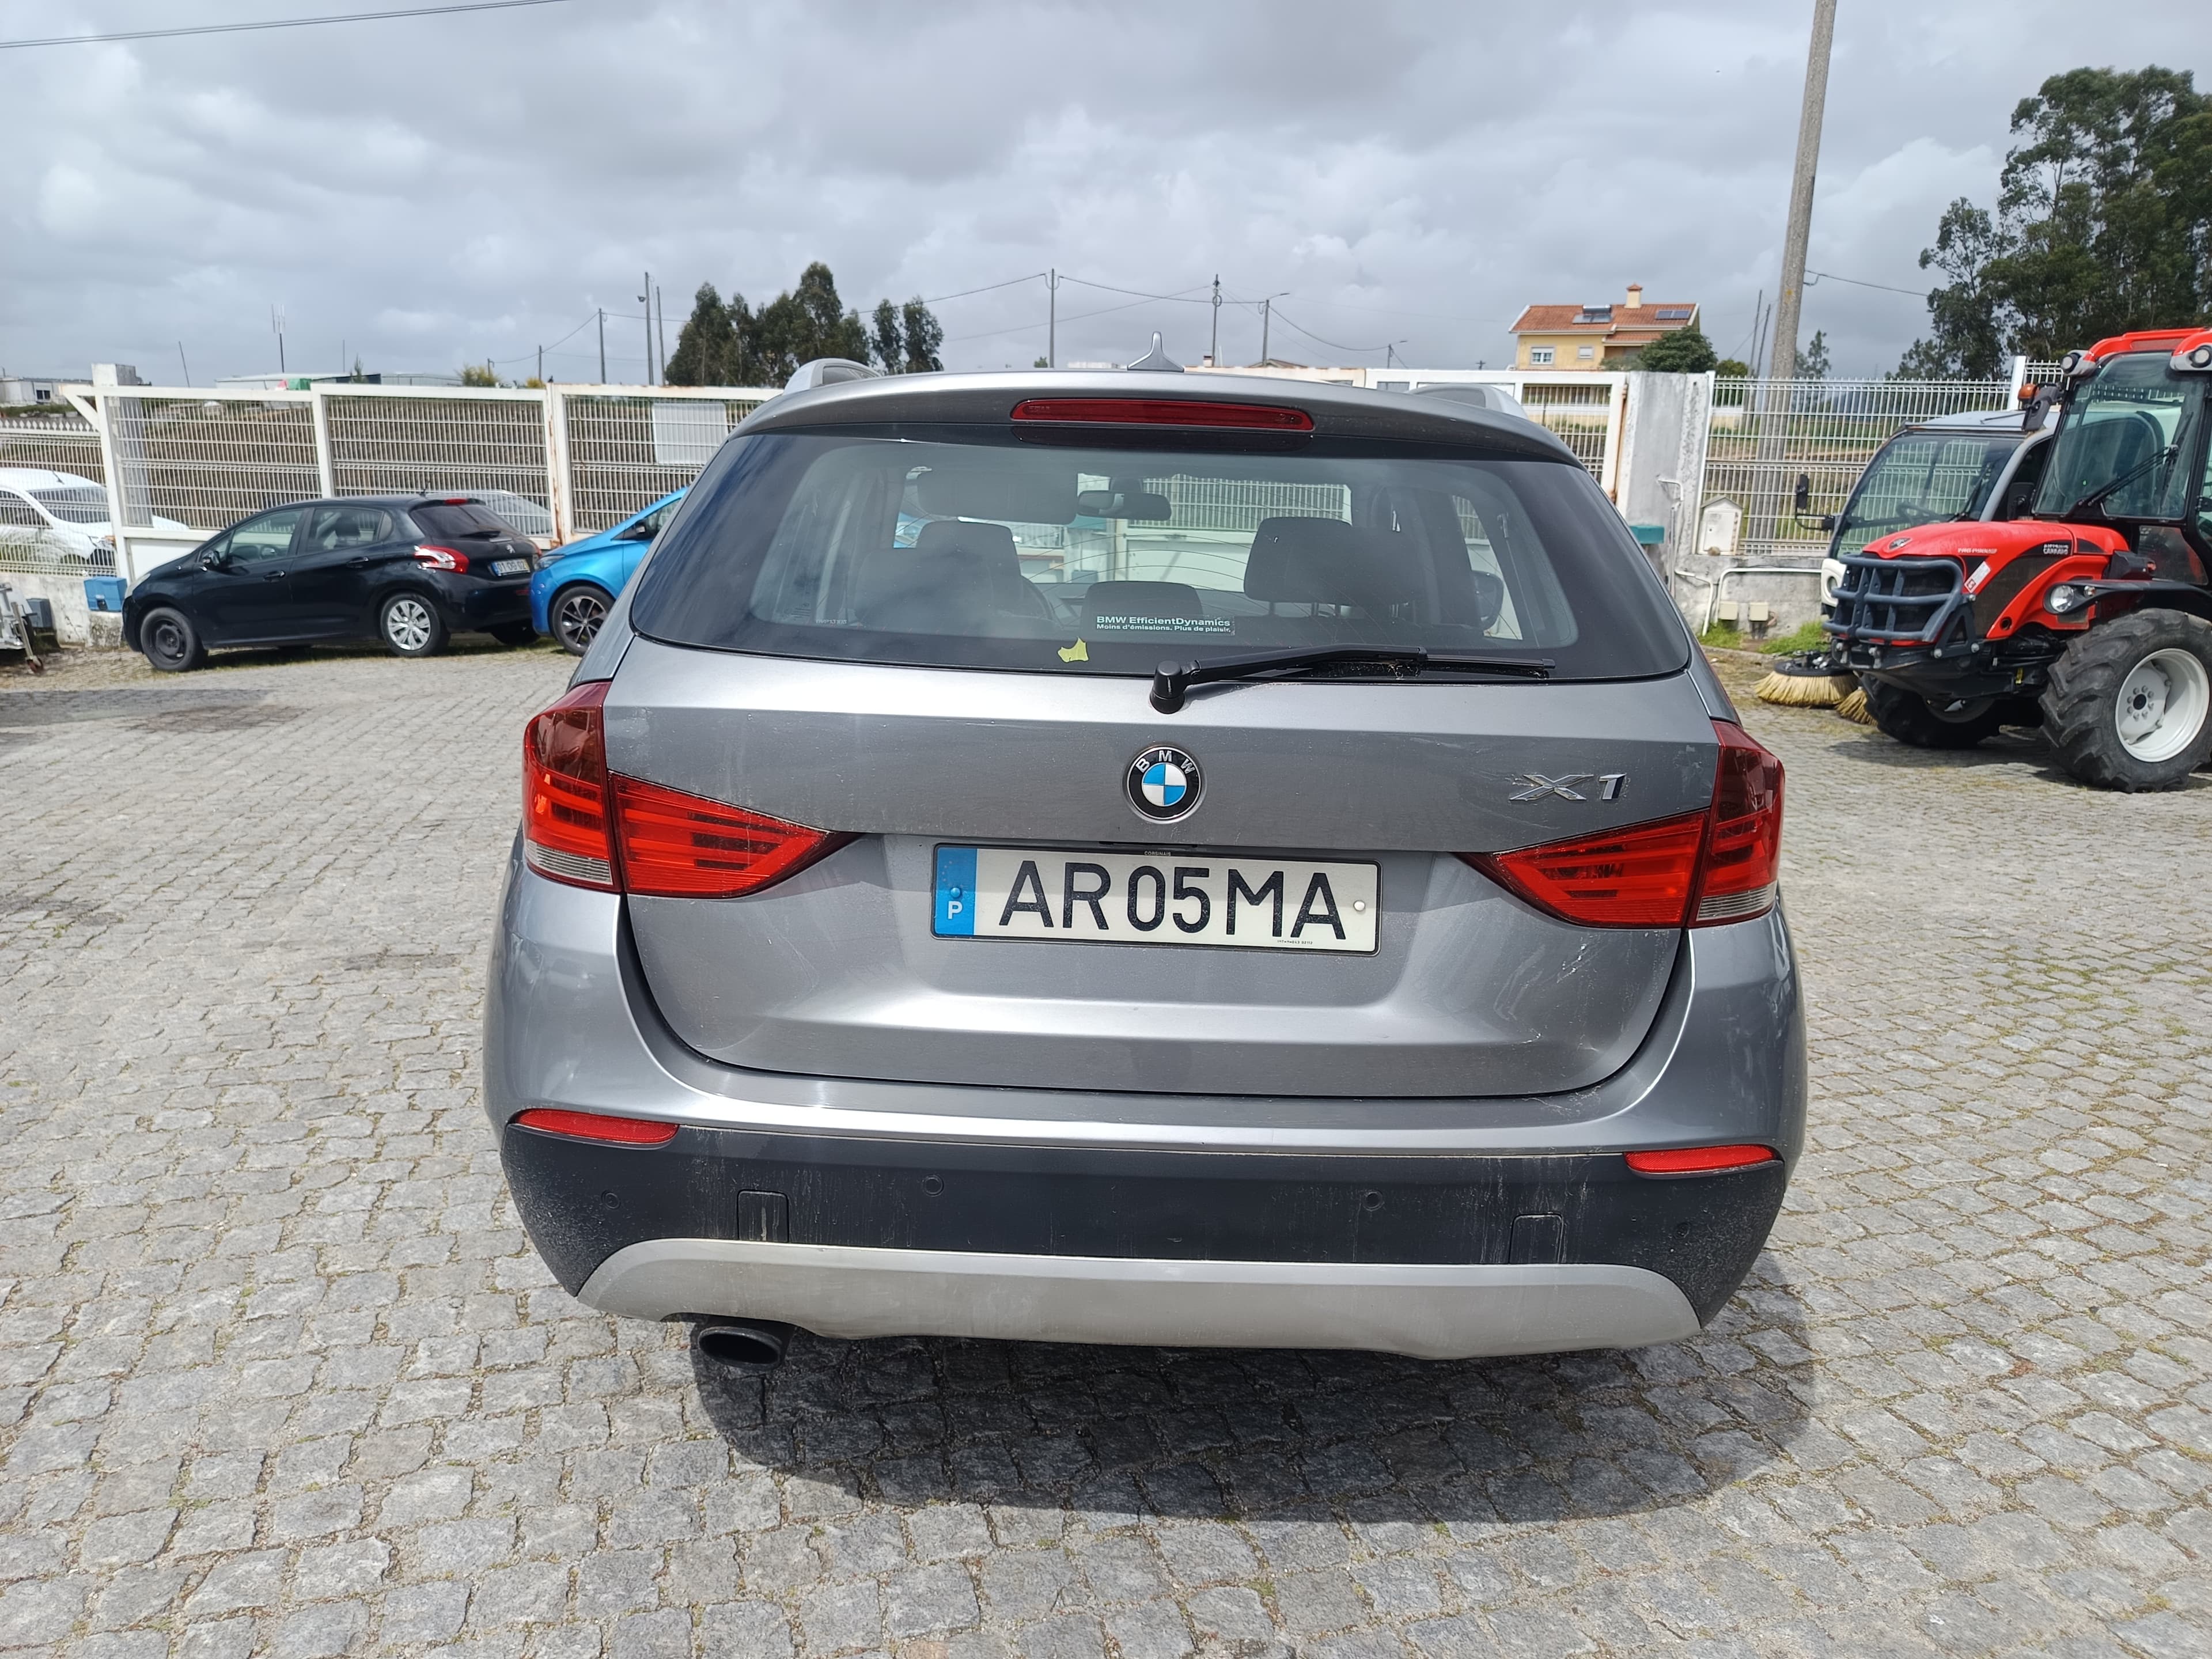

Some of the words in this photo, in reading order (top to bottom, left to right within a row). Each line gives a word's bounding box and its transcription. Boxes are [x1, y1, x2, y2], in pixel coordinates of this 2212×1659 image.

[1097, 616, 1127, 624] BMW
[1129, 617, 1230, 627] EfficientDynamics
[1135, 750, 1195, 775] BMW
[1509, 774, 1627, 801] X1
[947, 900, 963, 920] P
